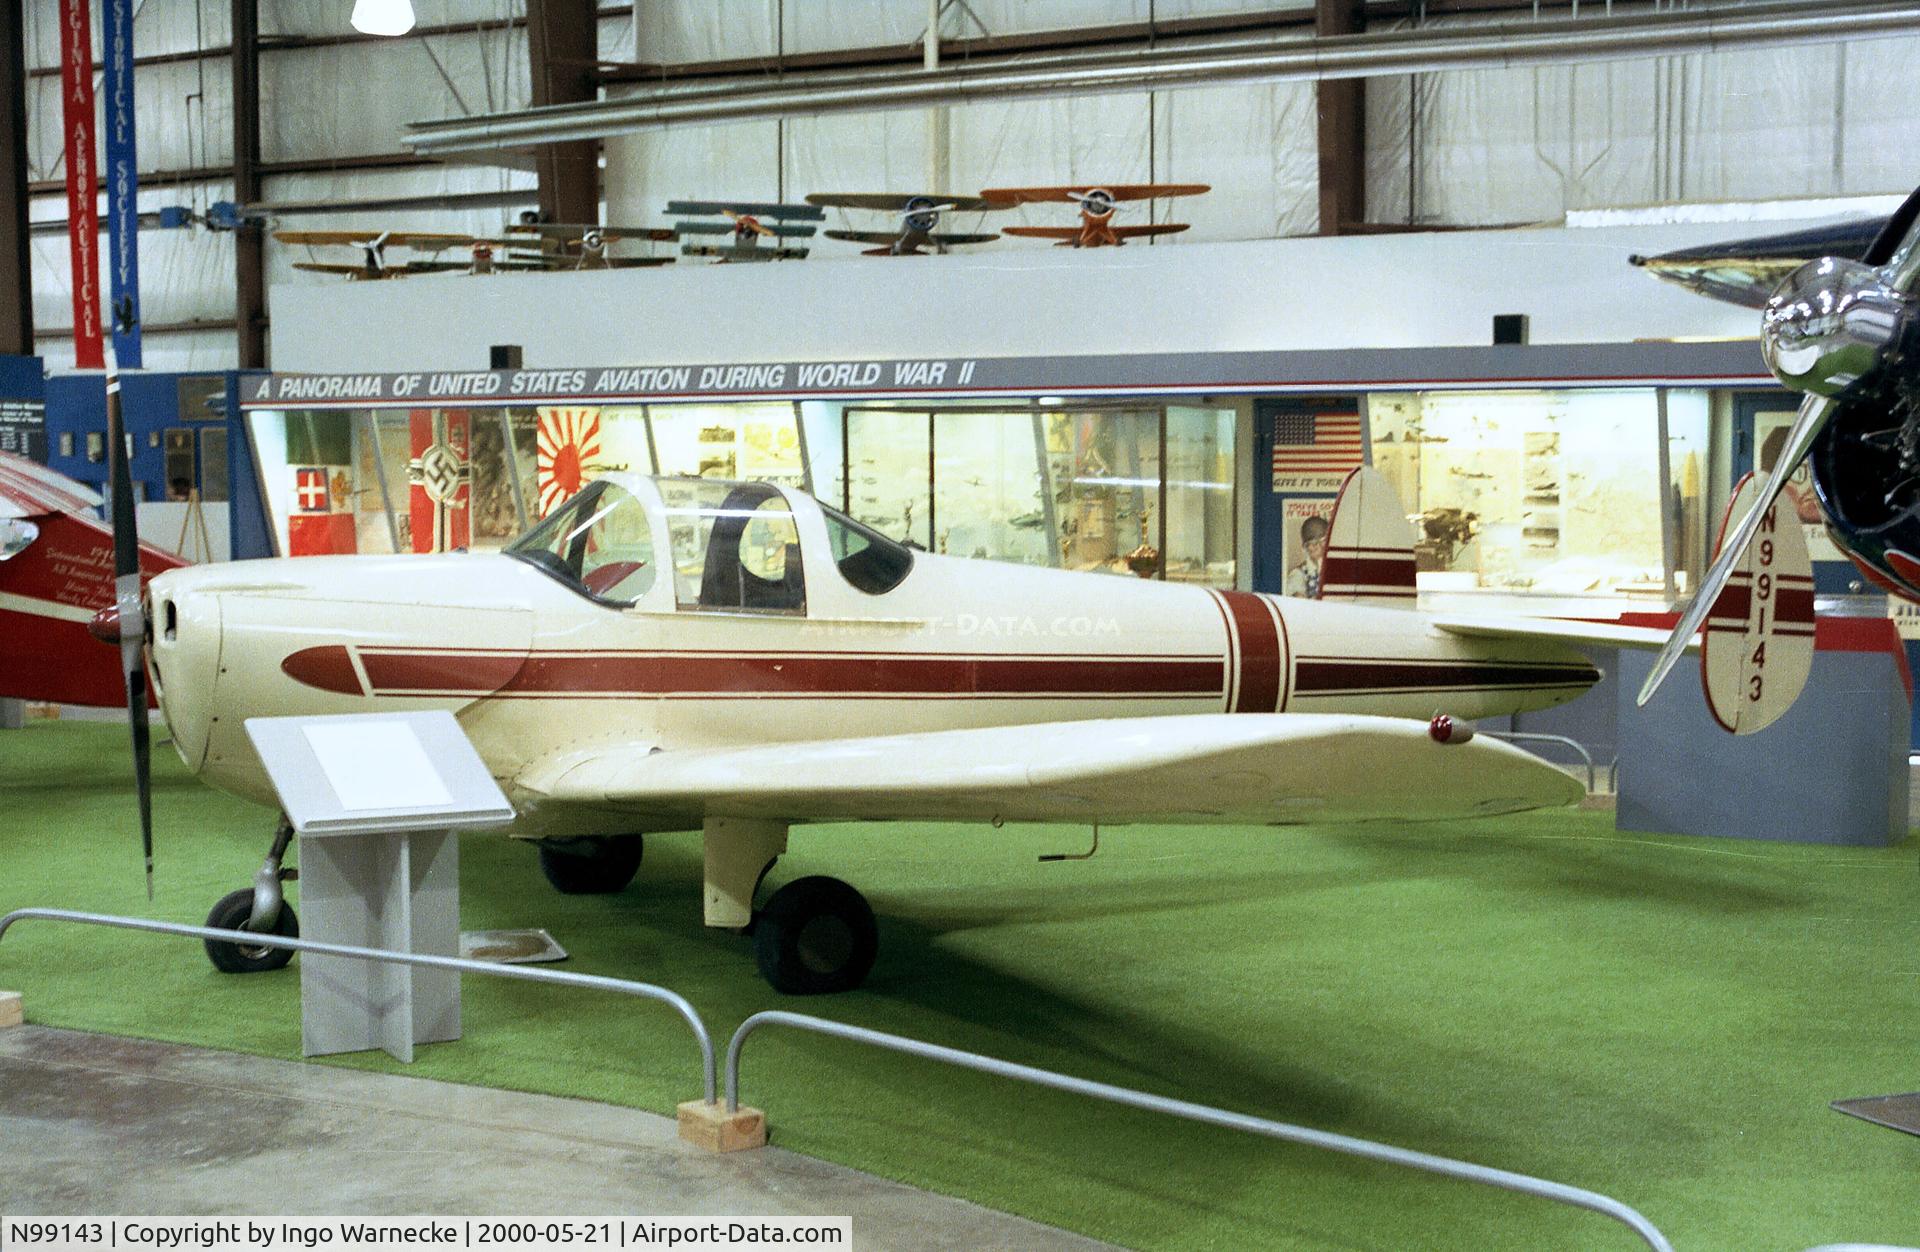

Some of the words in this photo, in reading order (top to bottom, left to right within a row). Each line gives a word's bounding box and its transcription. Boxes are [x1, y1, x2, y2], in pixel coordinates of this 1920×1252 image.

[73, 121, 95, 338] AERONAUTICAL
[116, 159, 129, 285] SOCIETY
[256, 377, 271, 399] A
[279, 376, 382, 398] PANORAMA
[392, 375, 422, 396] OF
[428, 373, 500, 395] UNITED
[510, 371, 586, 394] STATES
[594, 368, 690, 392] AVIATION
[699, 365, 786, 390] DURING
[797, 363, 881, 387] WORLD
[894, 362, 947, 385] WAR
[957, 361, 976, 385] II
[1300, 478, 1312, 487] IT
[1749, 504, 1777, 701] N99143
